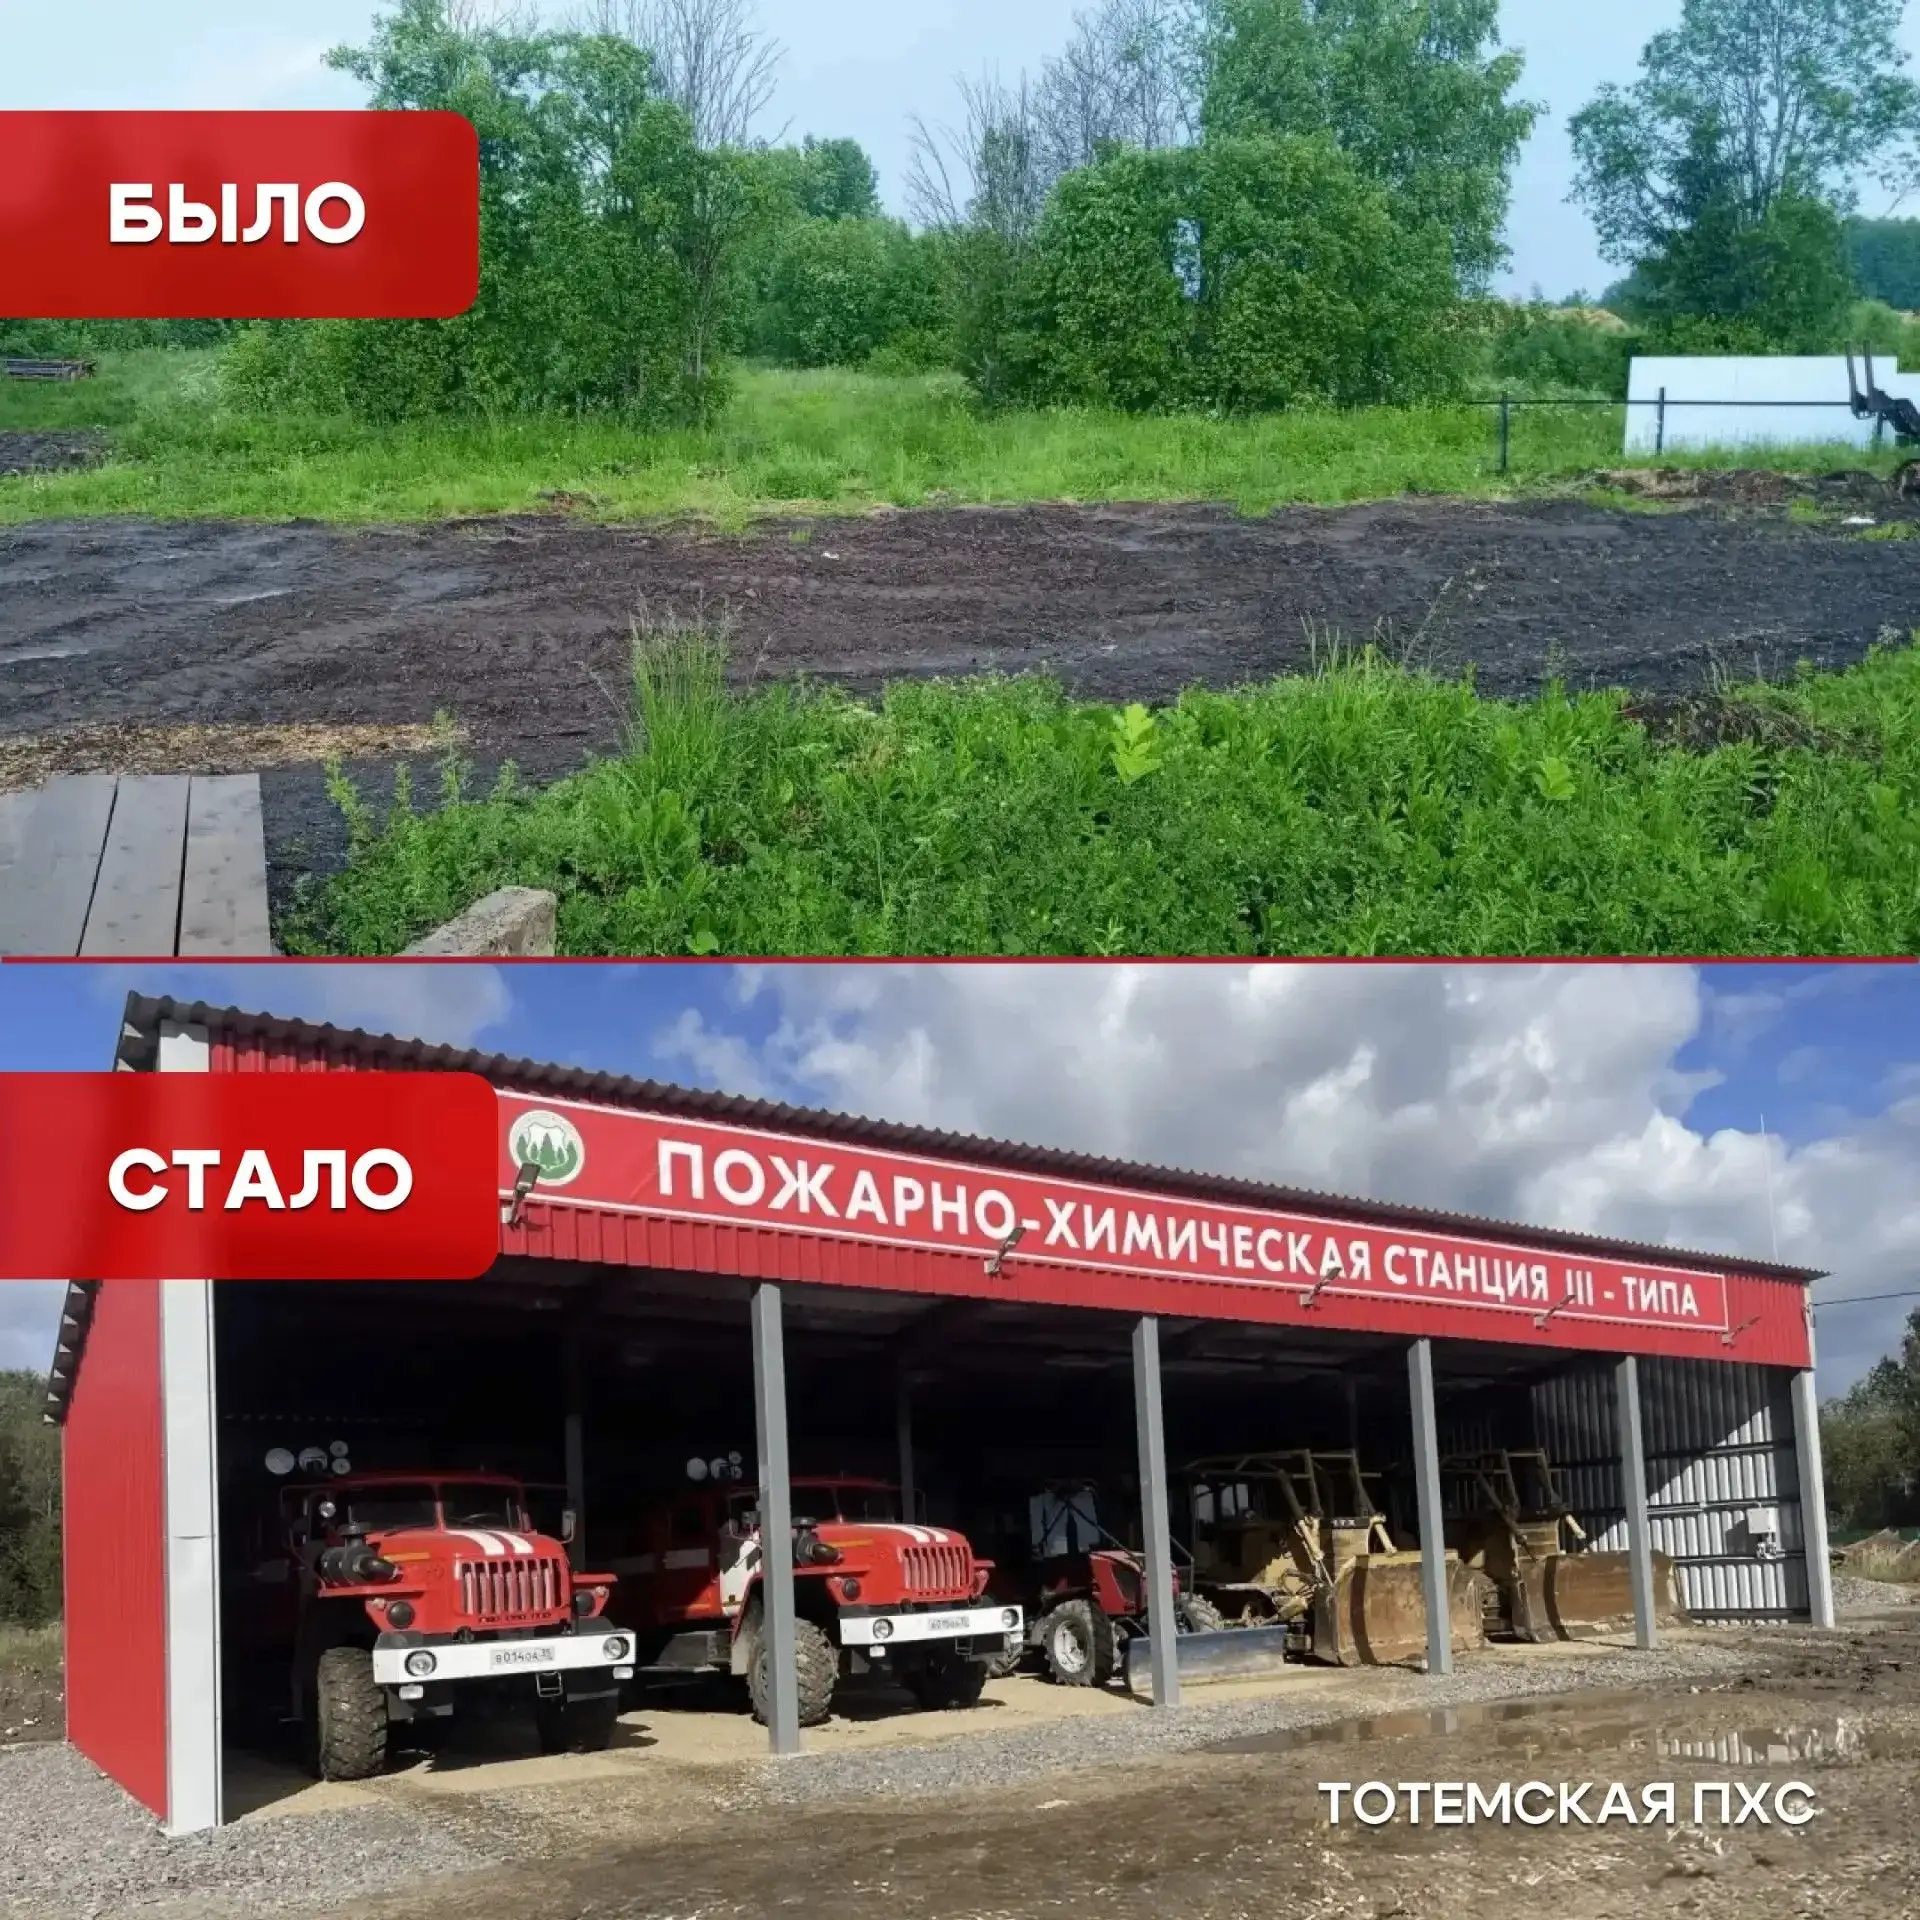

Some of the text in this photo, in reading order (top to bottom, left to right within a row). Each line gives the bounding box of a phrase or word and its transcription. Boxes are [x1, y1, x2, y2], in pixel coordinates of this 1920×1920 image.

[656, 1138, 1372, 1282] ПОЖАРНО-ХИМИЧЕСКАЯ
[1384, 1244, 1549, 1304] СТАНЦИЯ
[1622, 1276, 1699, 1317] ТИПА
